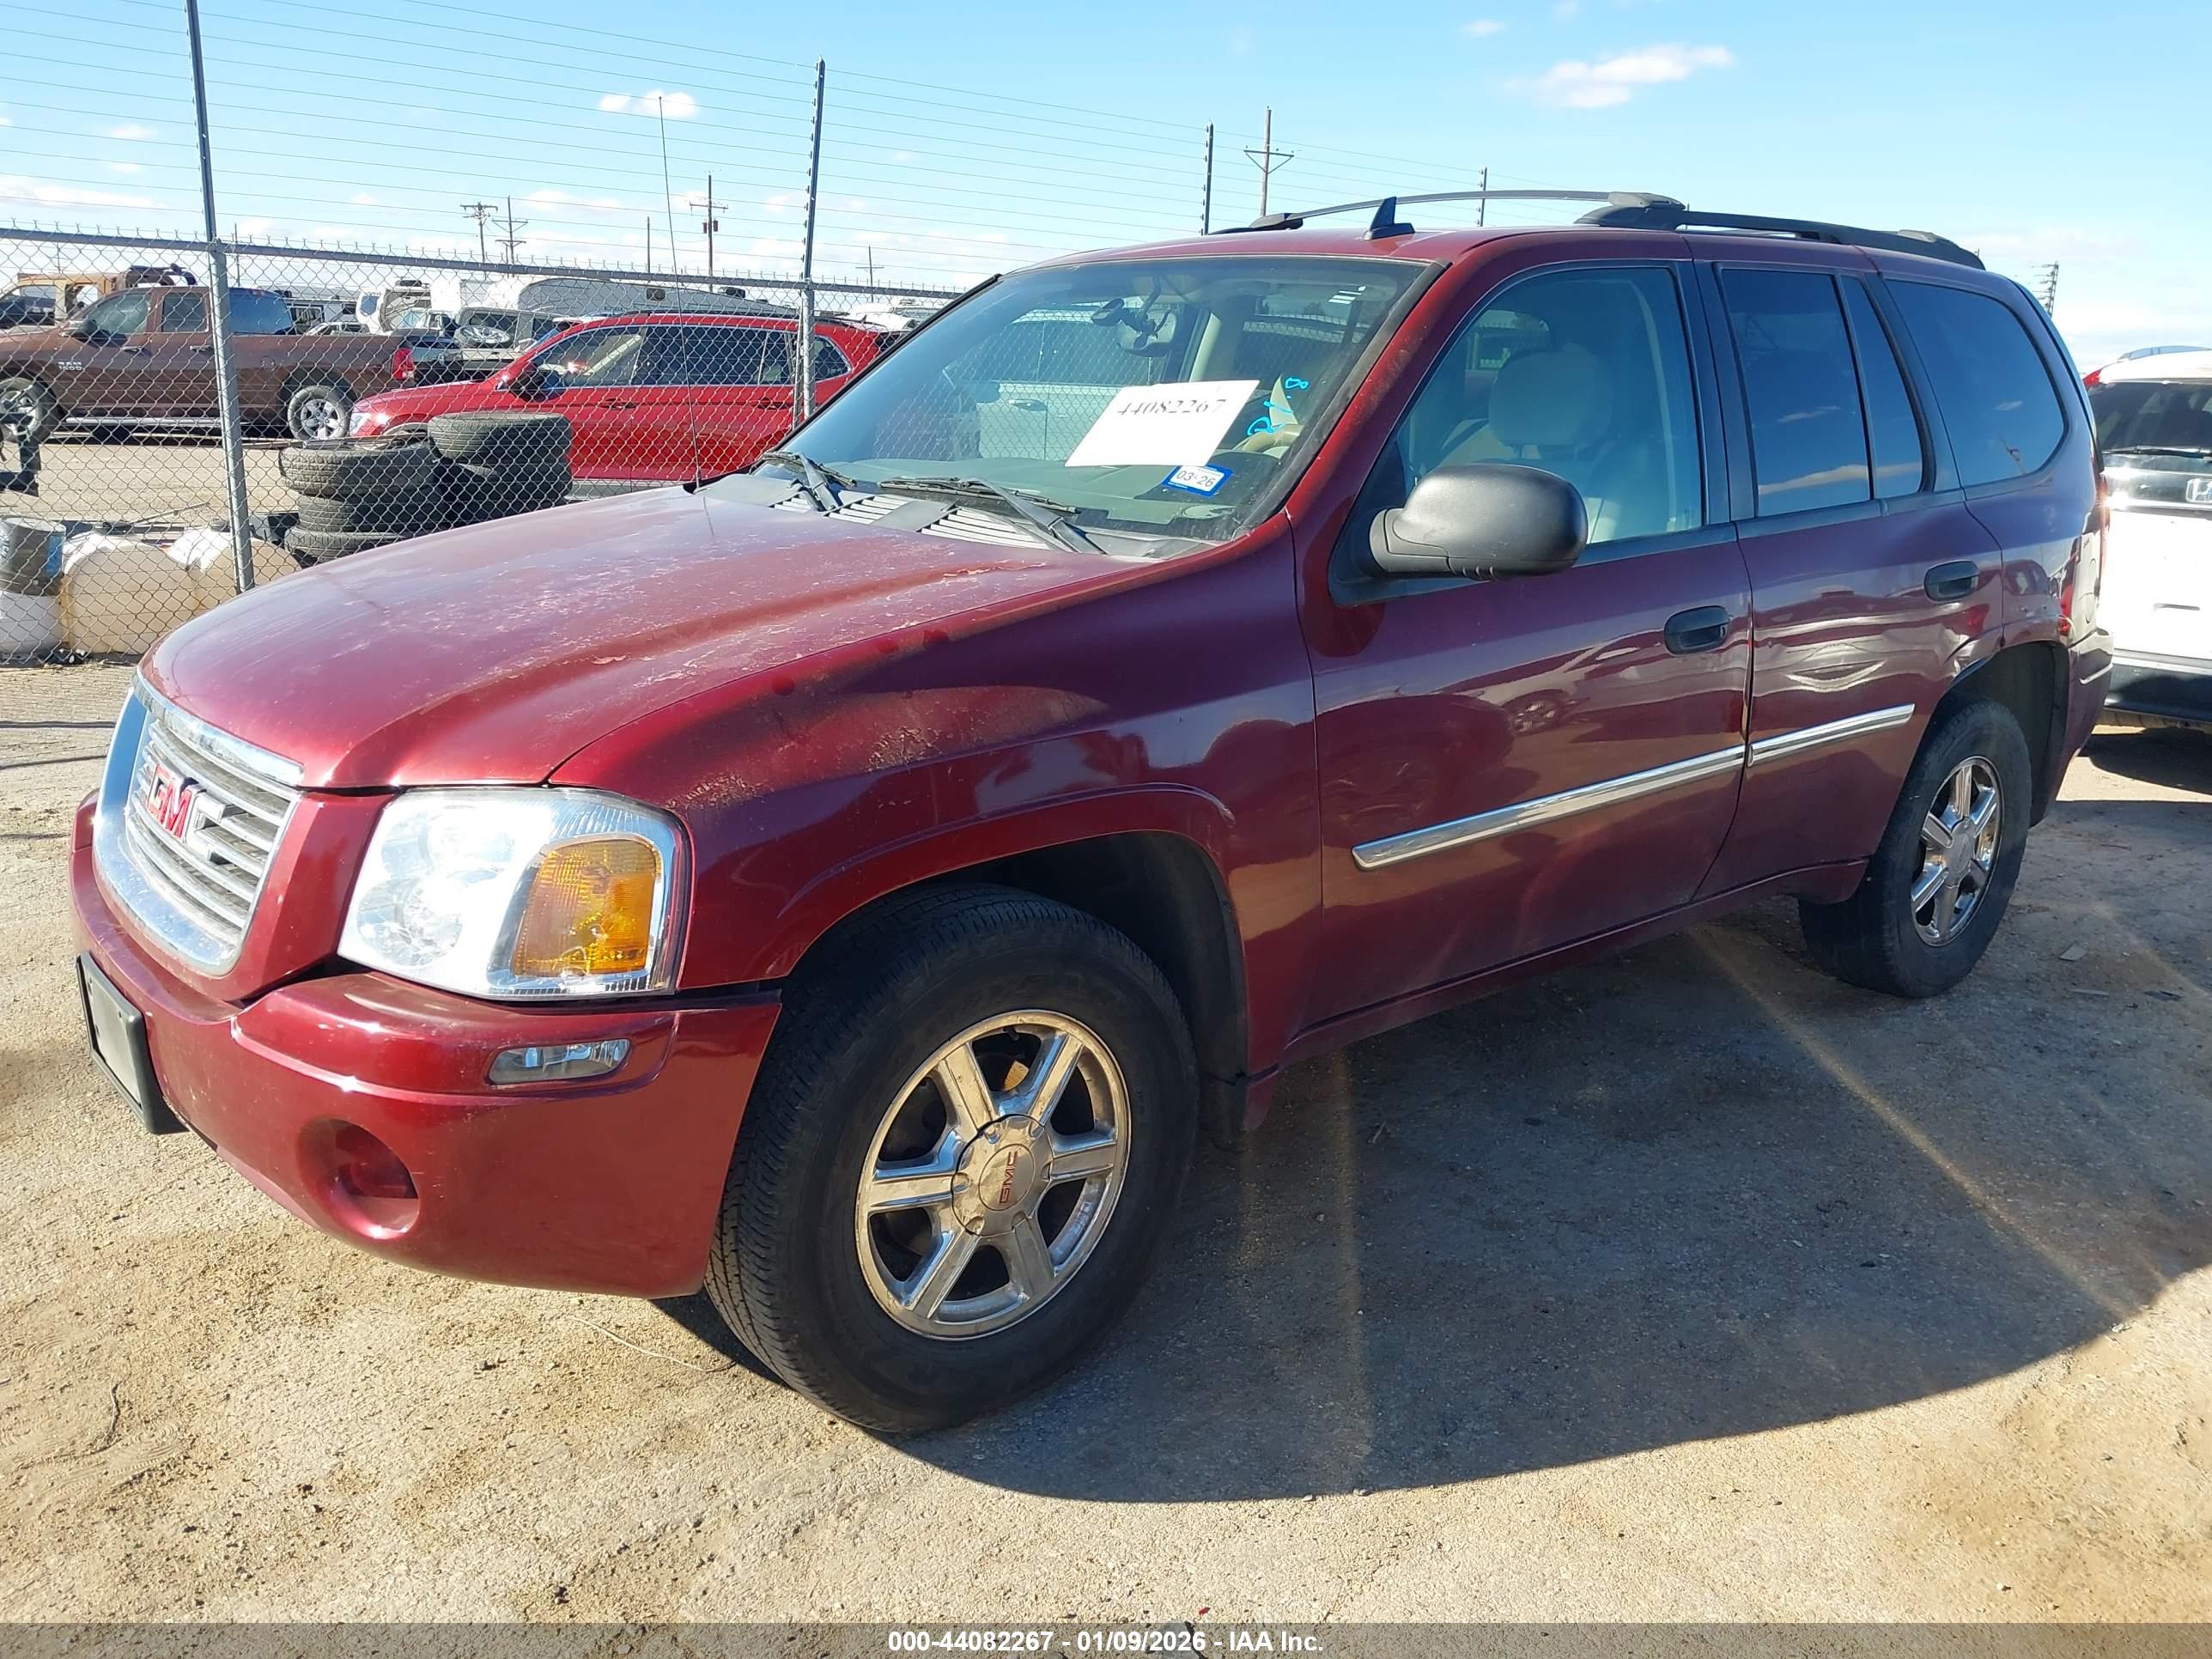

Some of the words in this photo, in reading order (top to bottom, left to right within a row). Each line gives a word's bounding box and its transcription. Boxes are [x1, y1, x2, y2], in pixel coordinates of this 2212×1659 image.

[1117, 399, 1227, 416] 44082267
[1176, 470, 1194, 482] 03
[1196, 475, 1216, 488] 26
[147, 763, 226, 865] GMC
[999, 1151, 1018, 1204] GMC
